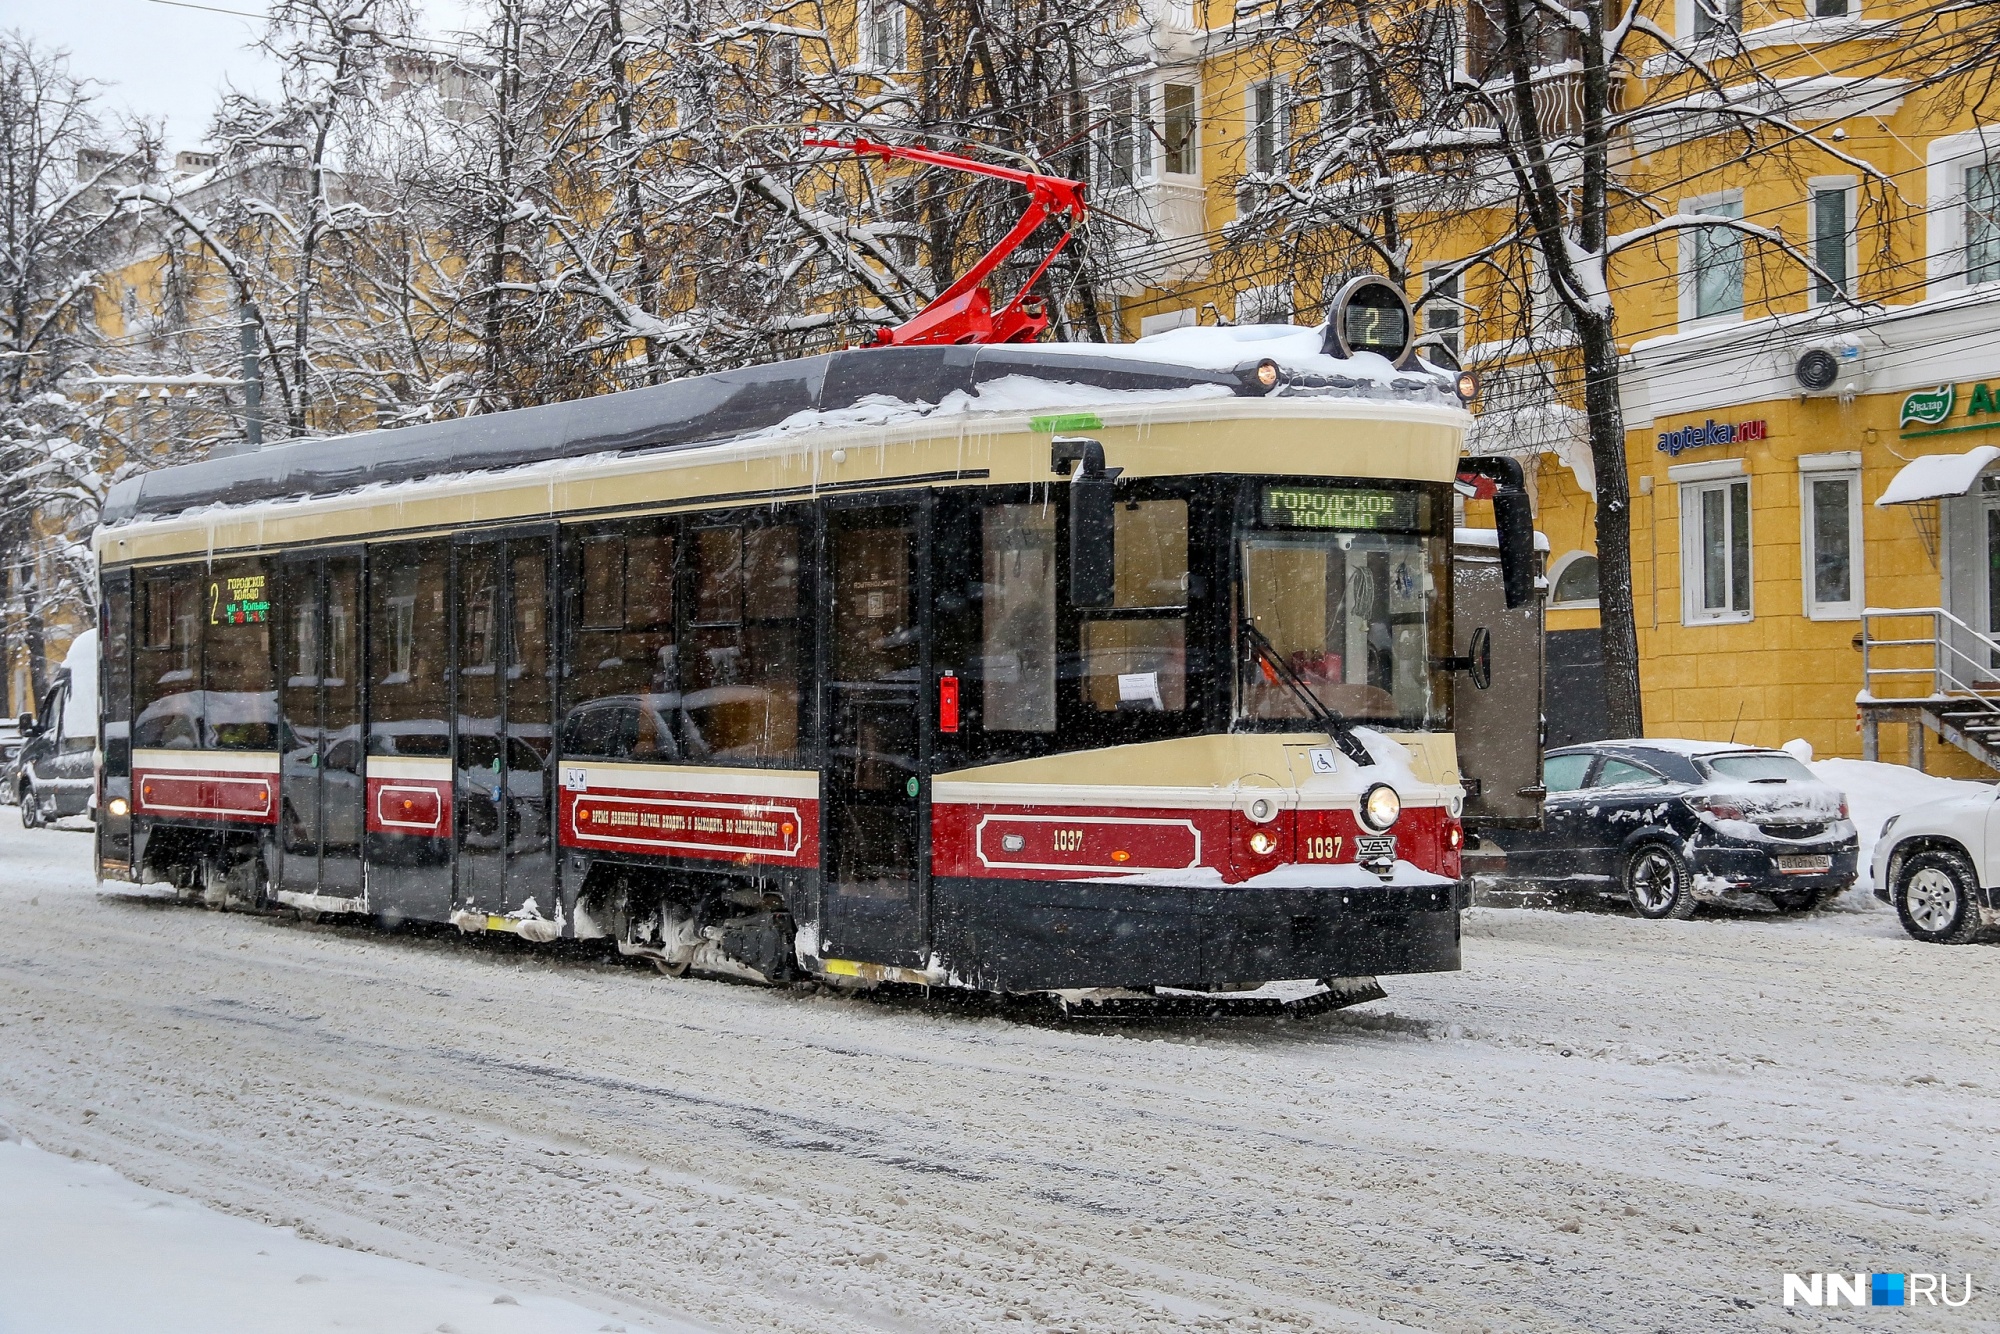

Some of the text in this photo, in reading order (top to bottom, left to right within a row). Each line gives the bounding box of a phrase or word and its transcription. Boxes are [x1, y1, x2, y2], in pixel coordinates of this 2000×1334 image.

[1365, 307, 1380, 344] 2
[1908, 401, 1943, 413] Эвалар
[1657, 418, 1766, 456] apteka.ru
[1270, 492, 1394, 513] ГОРОДСКОЕ
[1292, 510, 1374, 528] КОЛЬЦО
[227, 576, 265, 590] ГОРОДСКОЕ
[233, 587, 259, 601] КОЛЬЦО
[211, 583, 219, 625] 2
[592, 810, 609, 824] ВРЕМЯ
[610, 810, 638, 826] ДВИЖЕНИЯ
[640, 812, 660, 828] ВАГОНА
[662, 814, 685, 831] ВХОДИТЬ
[687, 816, 692, 830] И
[694, 816, 724, 834] ВЫХОДИТЬ
[735, 819, 778, 837] ЗАПРЕЩАЕТСЯ!
[1053, 829, 1083, 851] 1037
[1306, 836, 1343, 859] 1037
